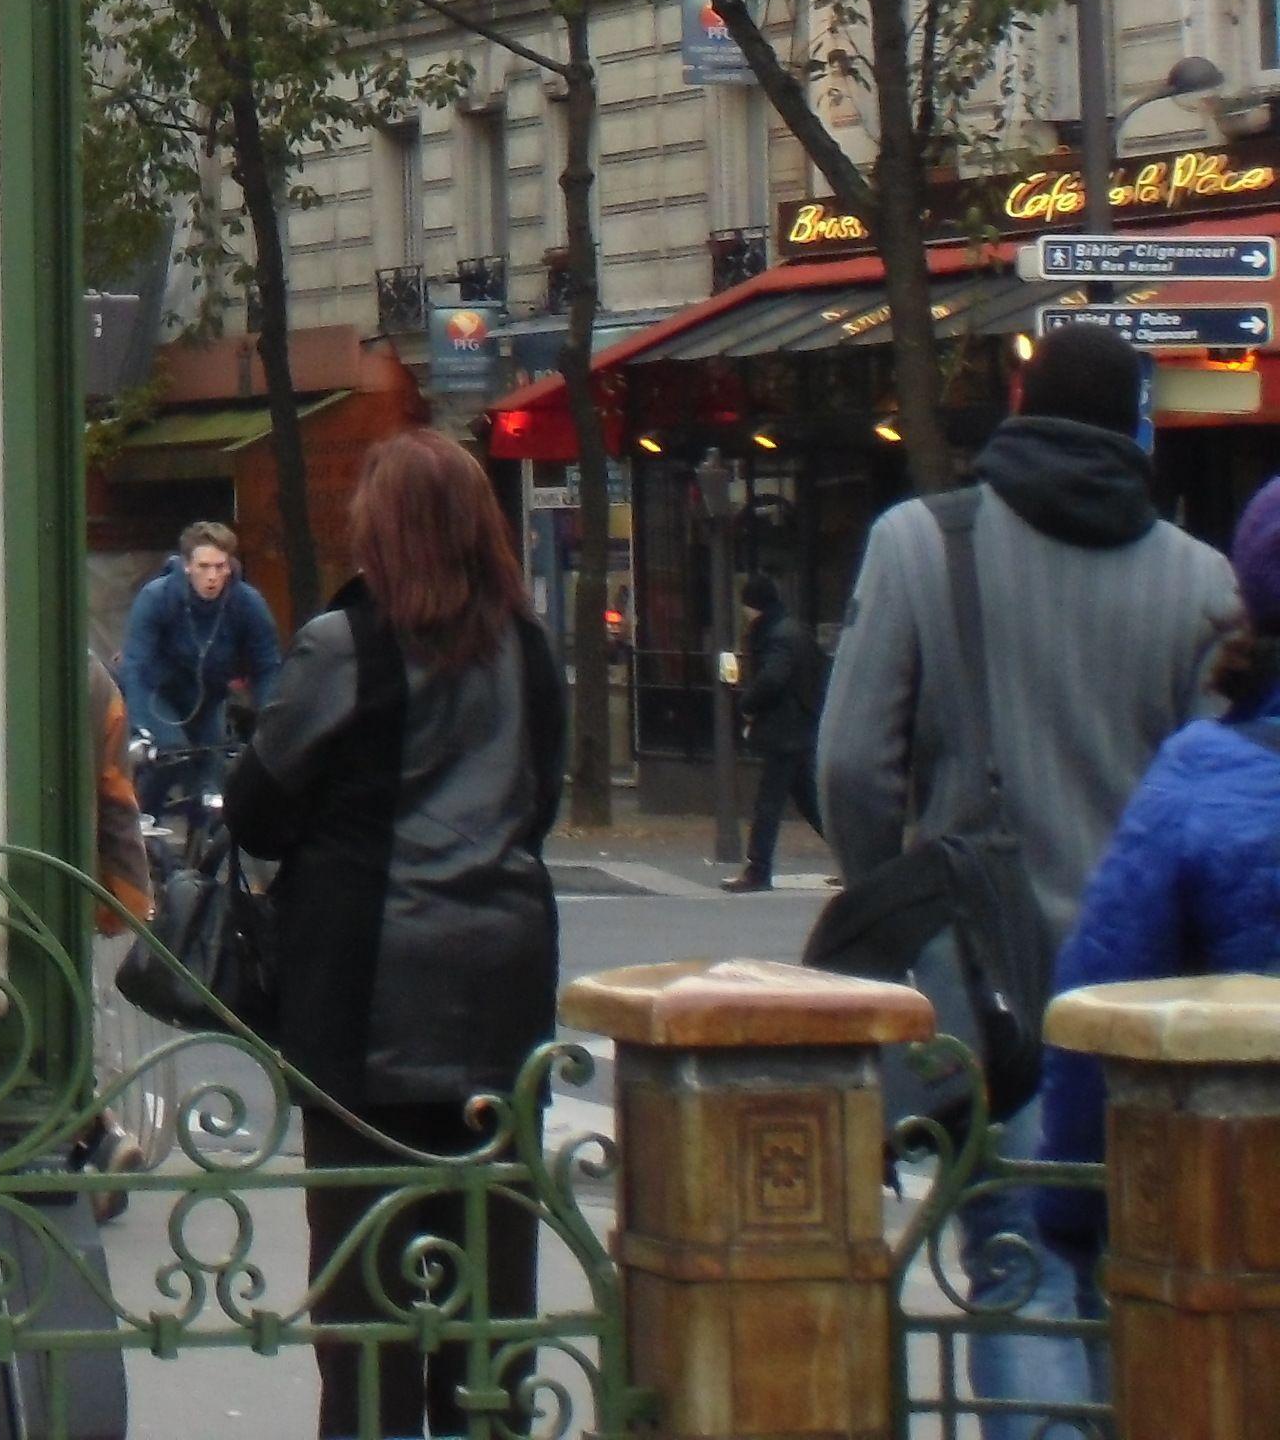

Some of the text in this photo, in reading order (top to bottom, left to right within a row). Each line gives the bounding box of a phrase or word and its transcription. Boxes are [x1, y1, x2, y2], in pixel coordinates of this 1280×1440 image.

[1006, 172, 1085, 222] Café
[1166, 152, 1274, 209] Place
[1135, 244, 1236, 260] Clignancourt
[1114, 313, 1133, 326] de
[1139, 312, 1182, 326] Police
